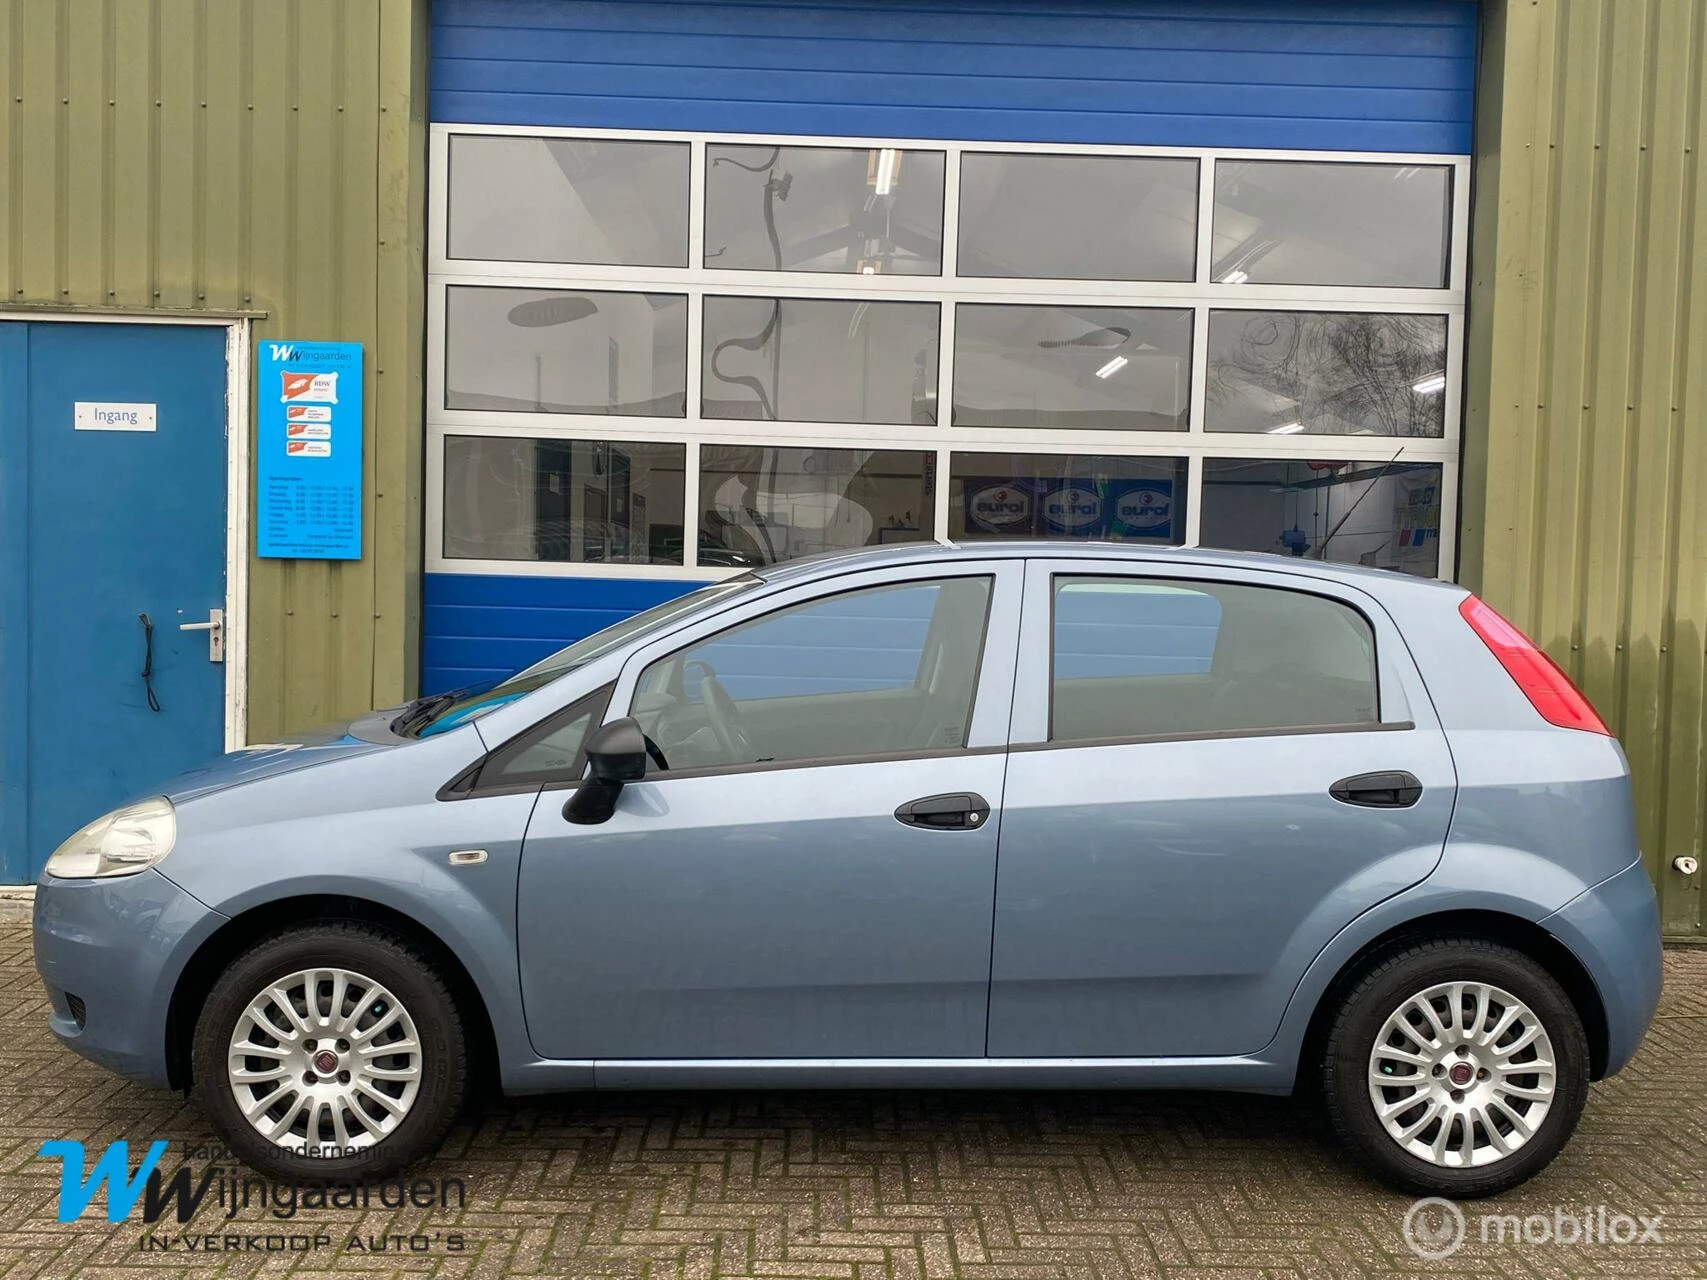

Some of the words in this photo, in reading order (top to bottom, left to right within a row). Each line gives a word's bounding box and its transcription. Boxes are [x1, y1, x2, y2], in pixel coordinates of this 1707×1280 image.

[94, 407, 138, 425] Ingang
[976, 501, 1024, 514] eurol
[1048, 501, 1097, 515] eurol
[1121, 501, 1170, 516] eurol
